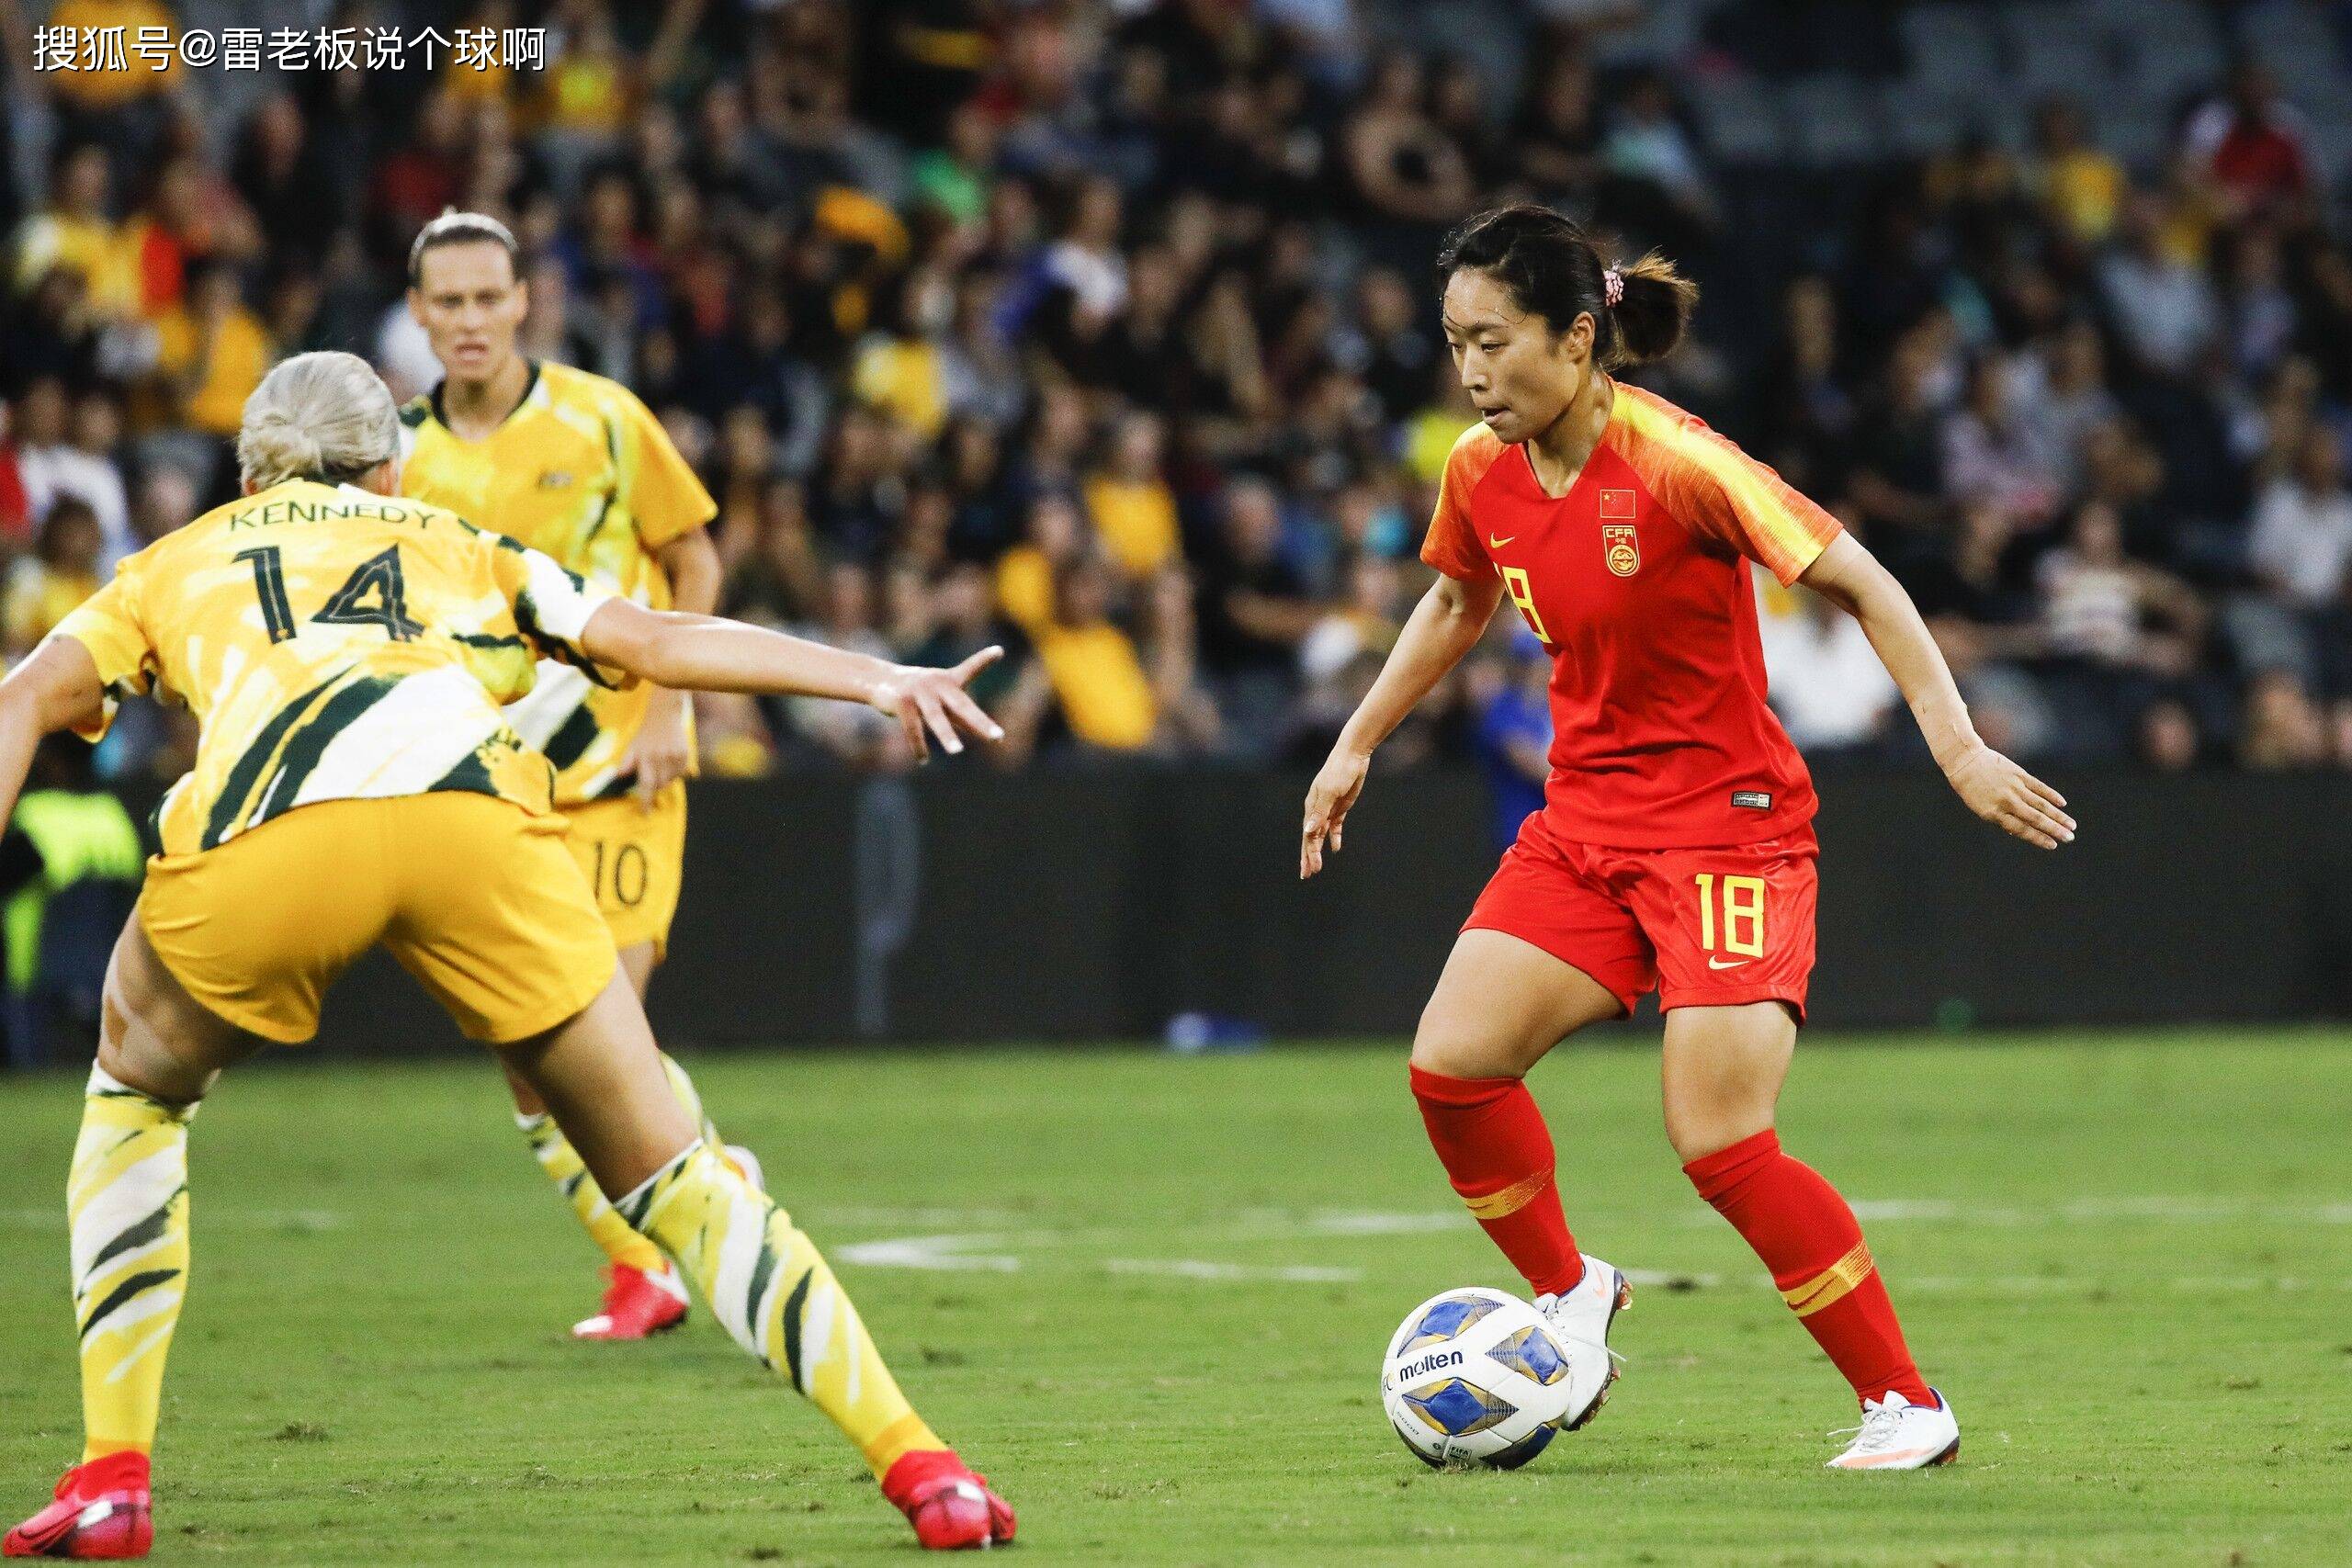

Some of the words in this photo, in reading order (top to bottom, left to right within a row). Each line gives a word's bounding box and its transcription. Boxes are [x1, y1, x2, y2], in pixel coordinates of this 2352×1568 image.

[230, 501, 435, 531] KENNEDY
[1605, 528, 1634, 537] CFA
[231, 542, 425, 645] 14
[1493, 561, 1553, 643] 8
[594, 840, 647, 906] 10
[1695, 873, 1765, 958] 18
[1399, 1350, 1464, 1382] molten
